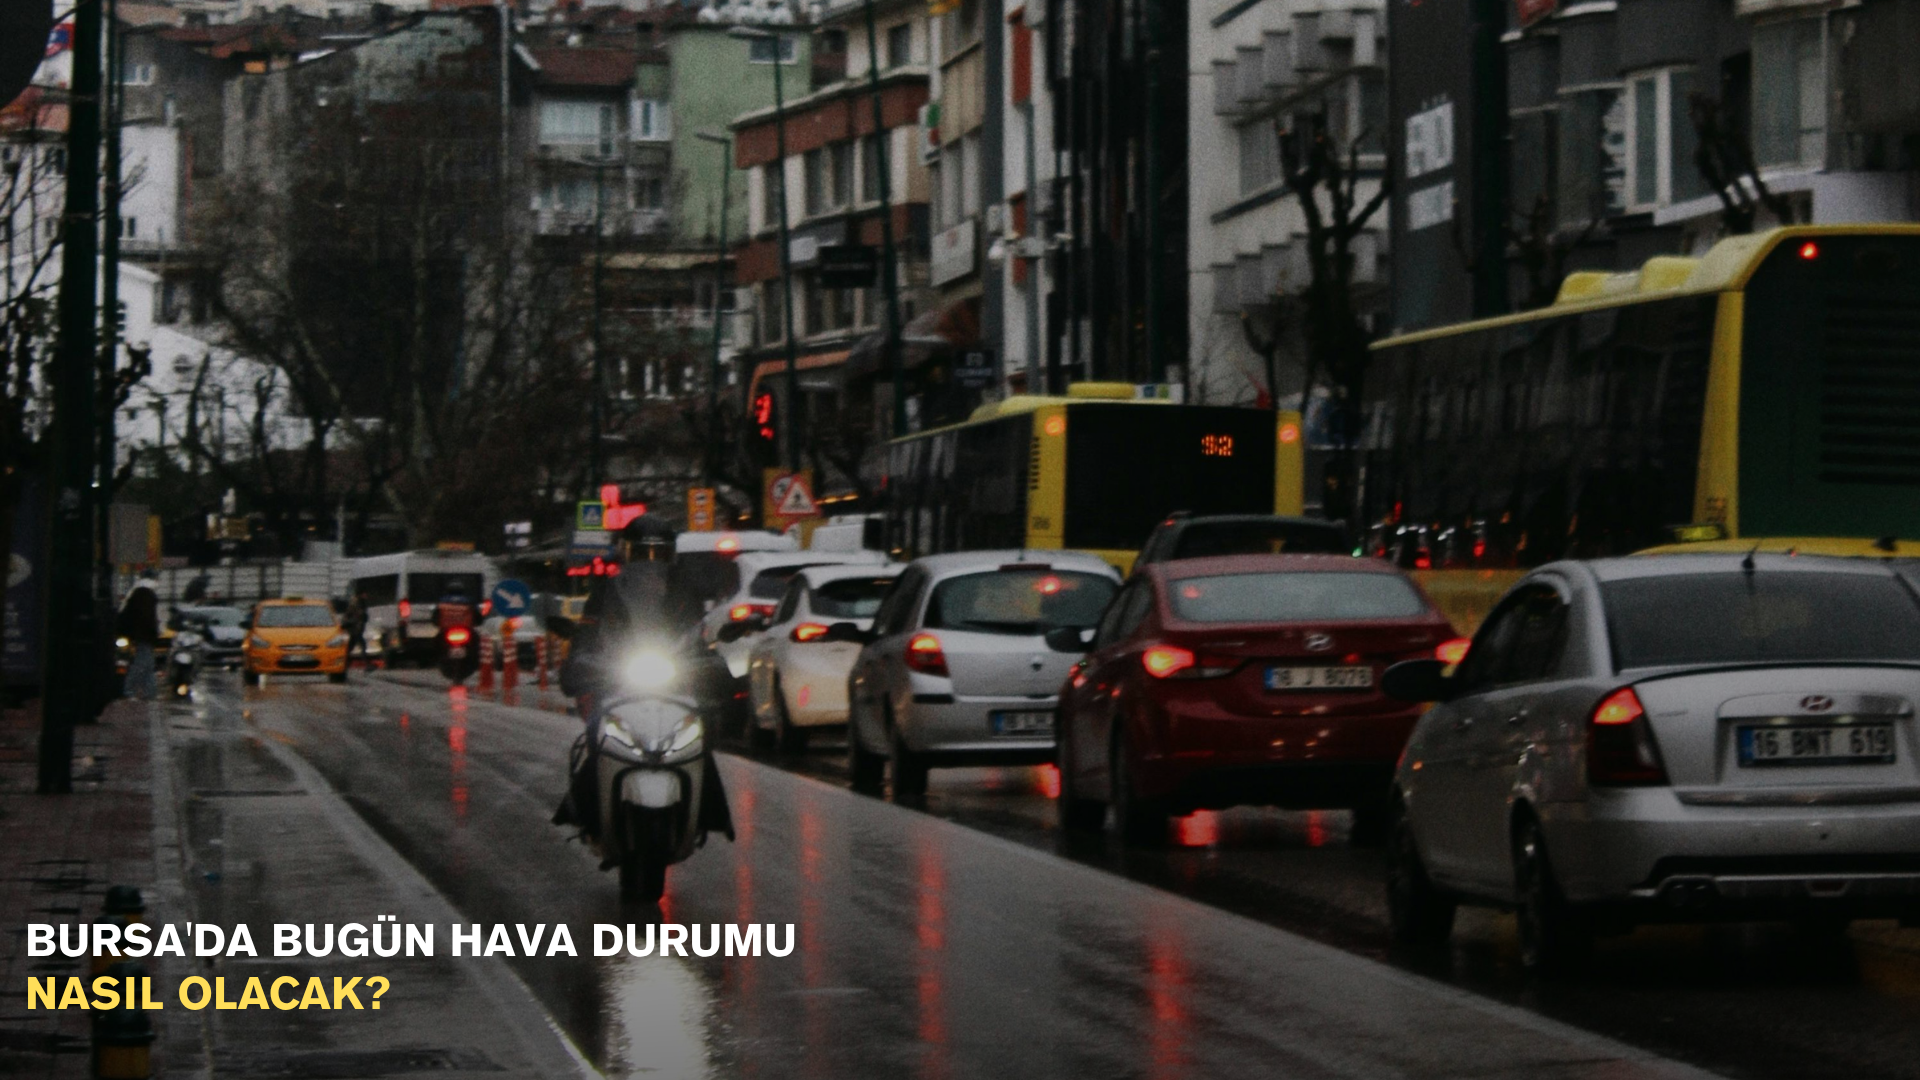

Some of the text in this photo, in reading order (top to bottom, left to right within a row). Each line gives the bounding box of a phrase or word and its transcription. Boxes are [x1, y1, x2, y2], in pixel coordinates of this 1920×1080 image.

[1755, 728, 1888, 756] 16 BNT 619
